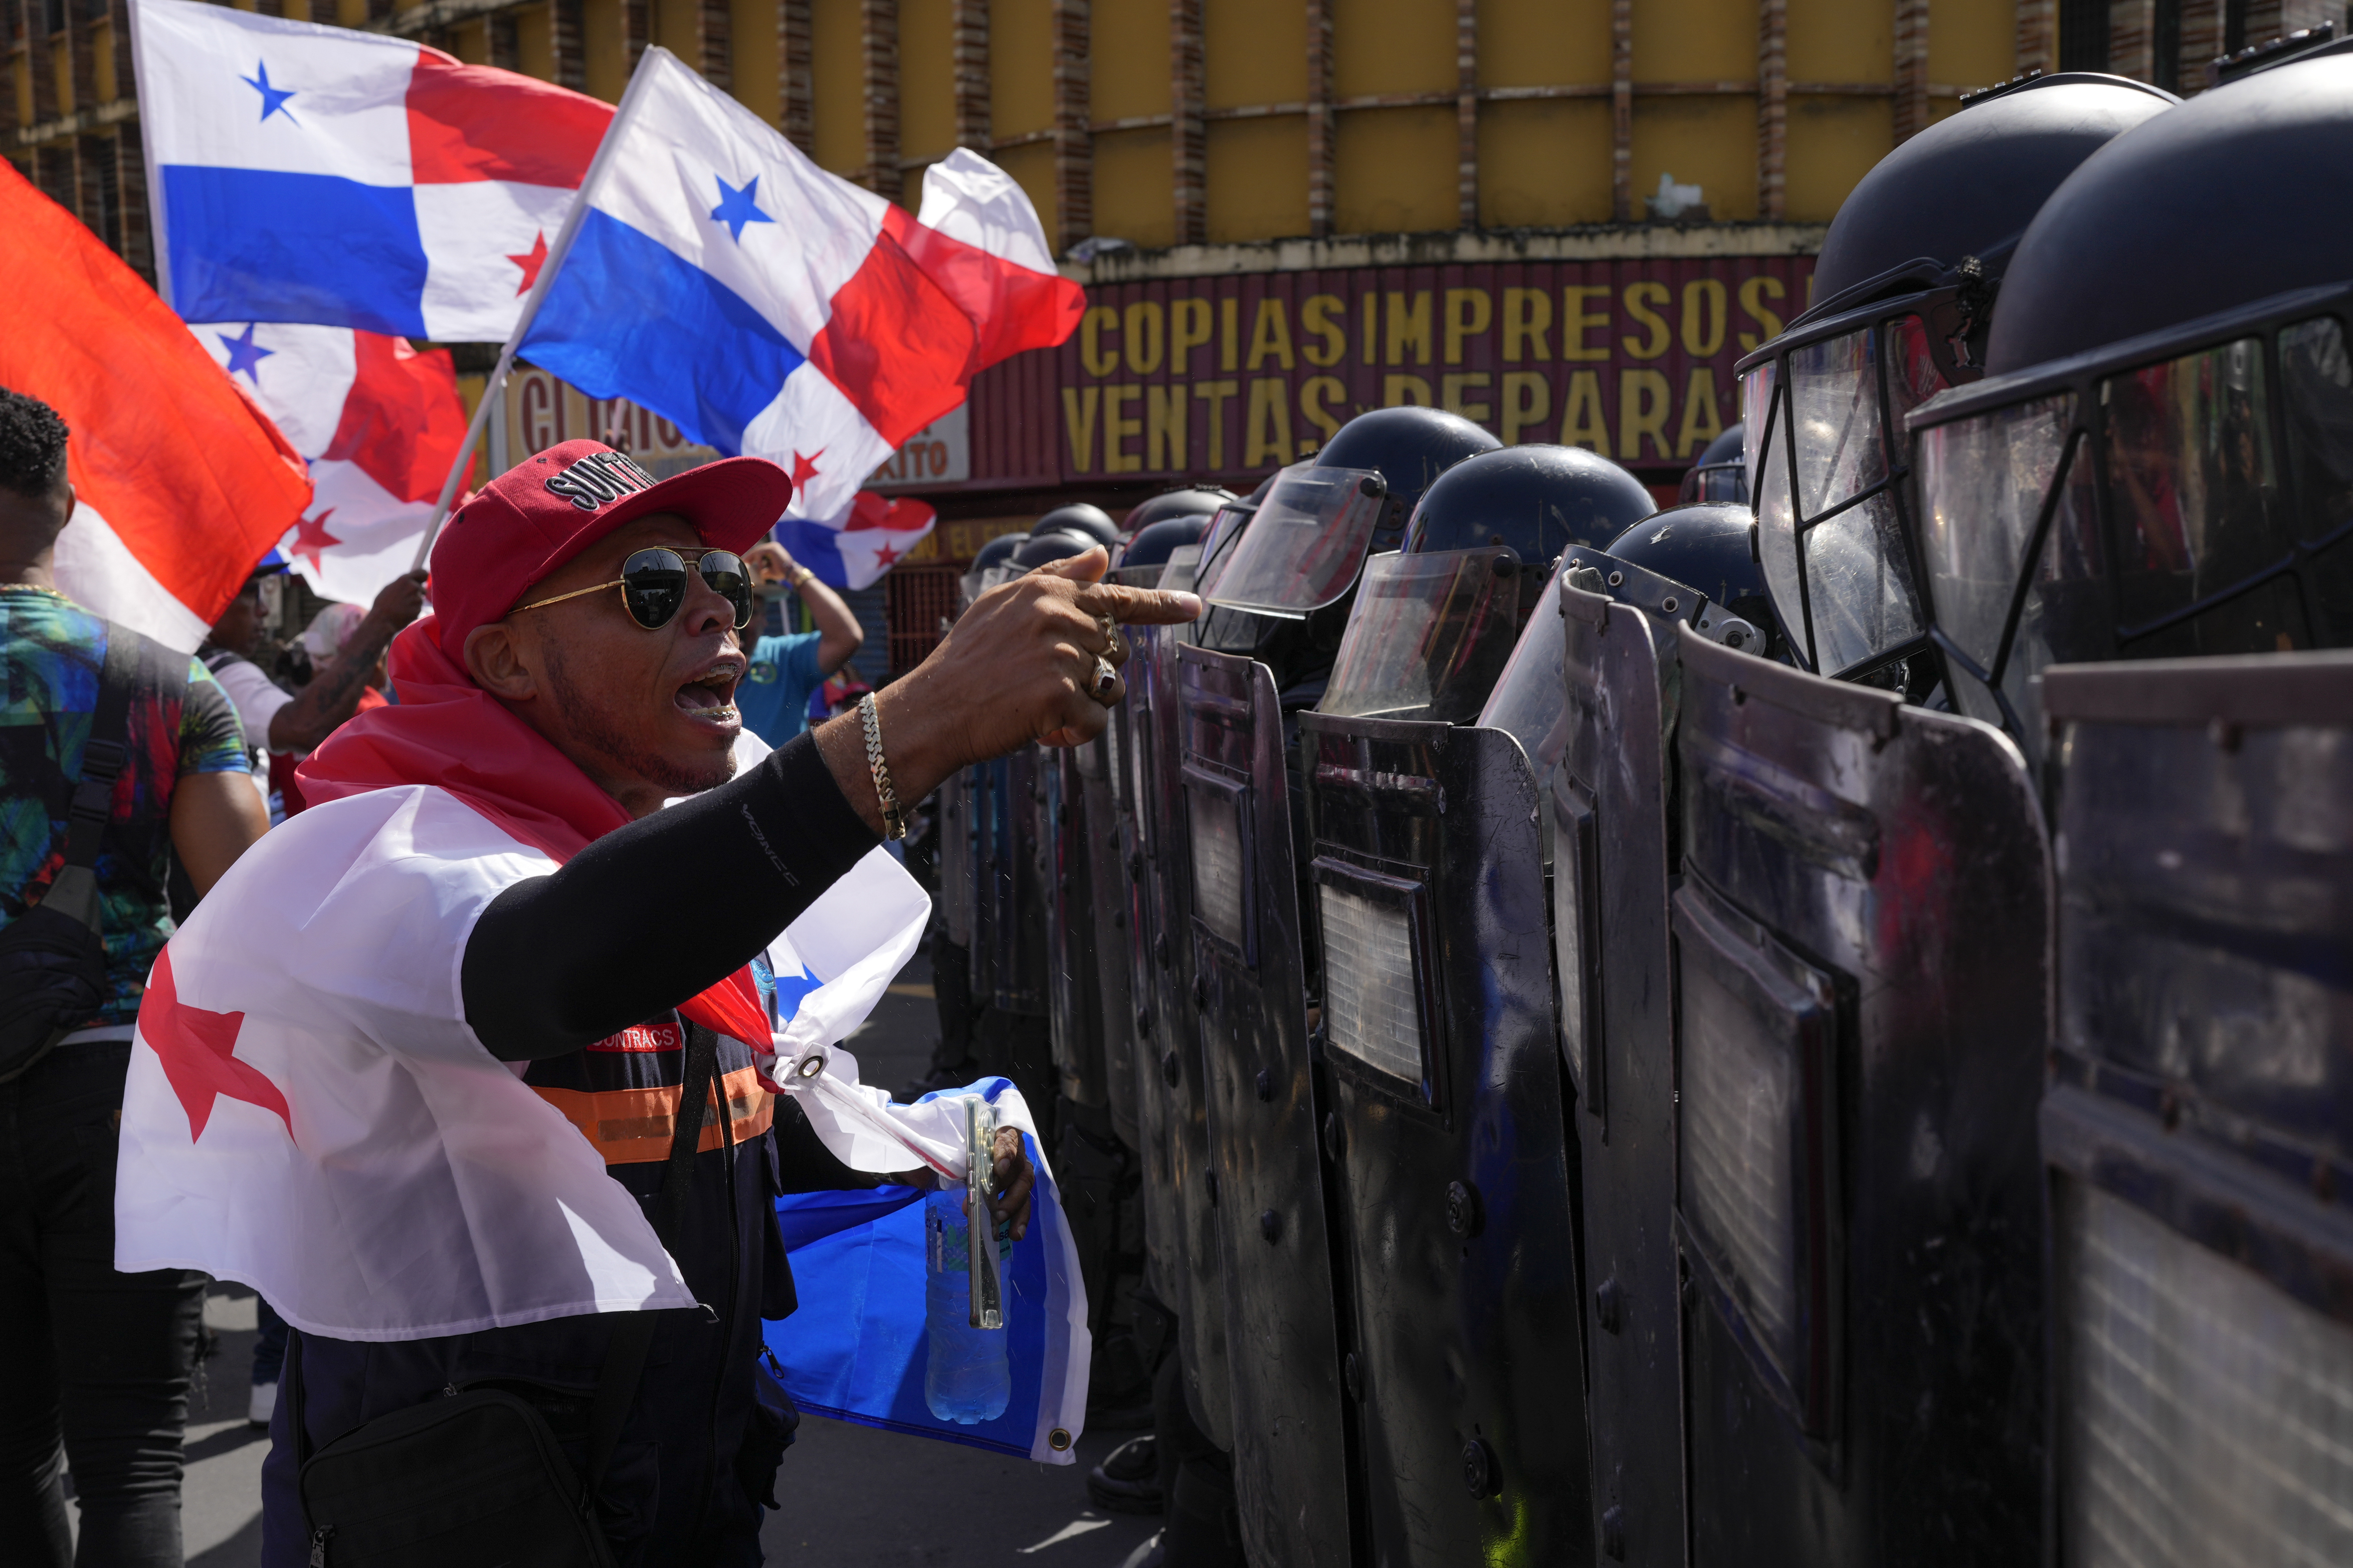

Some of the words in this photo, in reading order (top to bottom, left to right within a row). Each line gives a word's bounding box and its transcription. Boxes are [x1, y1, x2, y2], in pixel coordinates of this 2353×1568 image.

[1080, 294, 1347, 377] COPIAS
[1362, 276, 1786, 366] IMPRESOS
[1062, 375, 1347, 474] VENTAS
